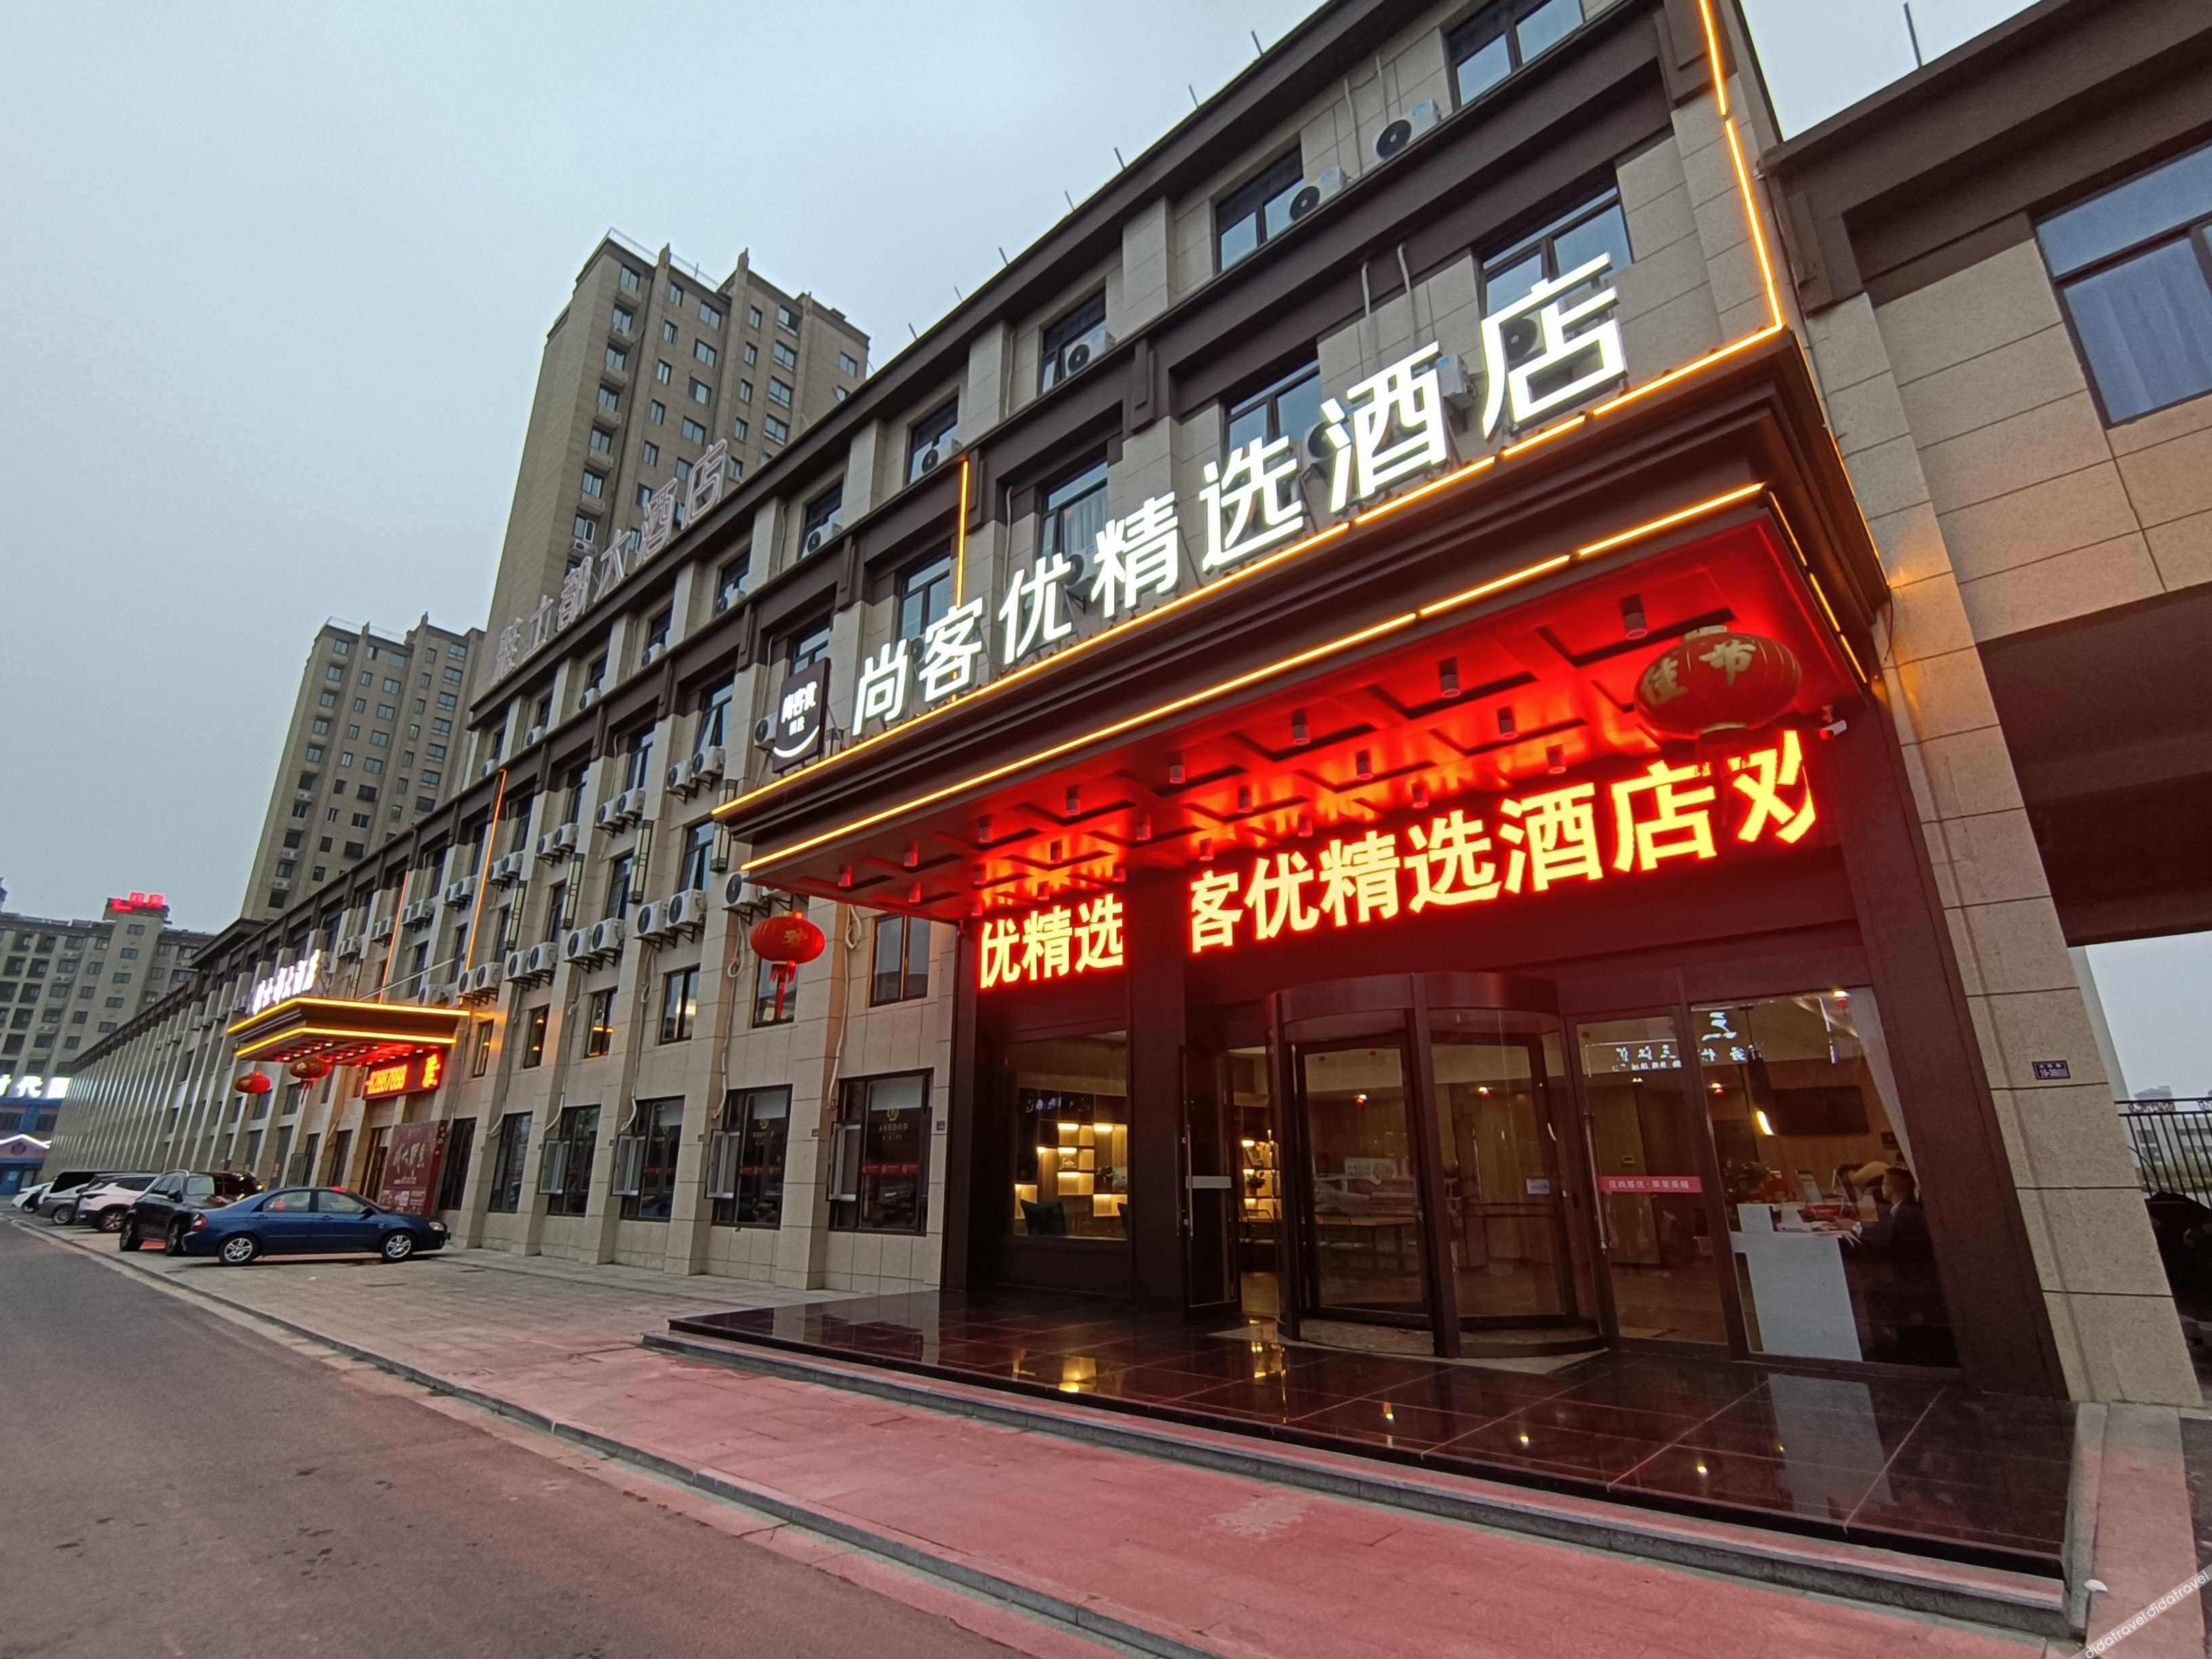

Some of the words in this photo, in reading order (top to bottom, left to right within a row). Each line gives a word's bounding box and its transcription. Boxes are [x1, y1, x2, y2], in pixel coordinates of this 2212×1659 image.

[853, 252, 1626, 736] 尚客优精选酒店
[980, 893, 1124, 989] 优精选
